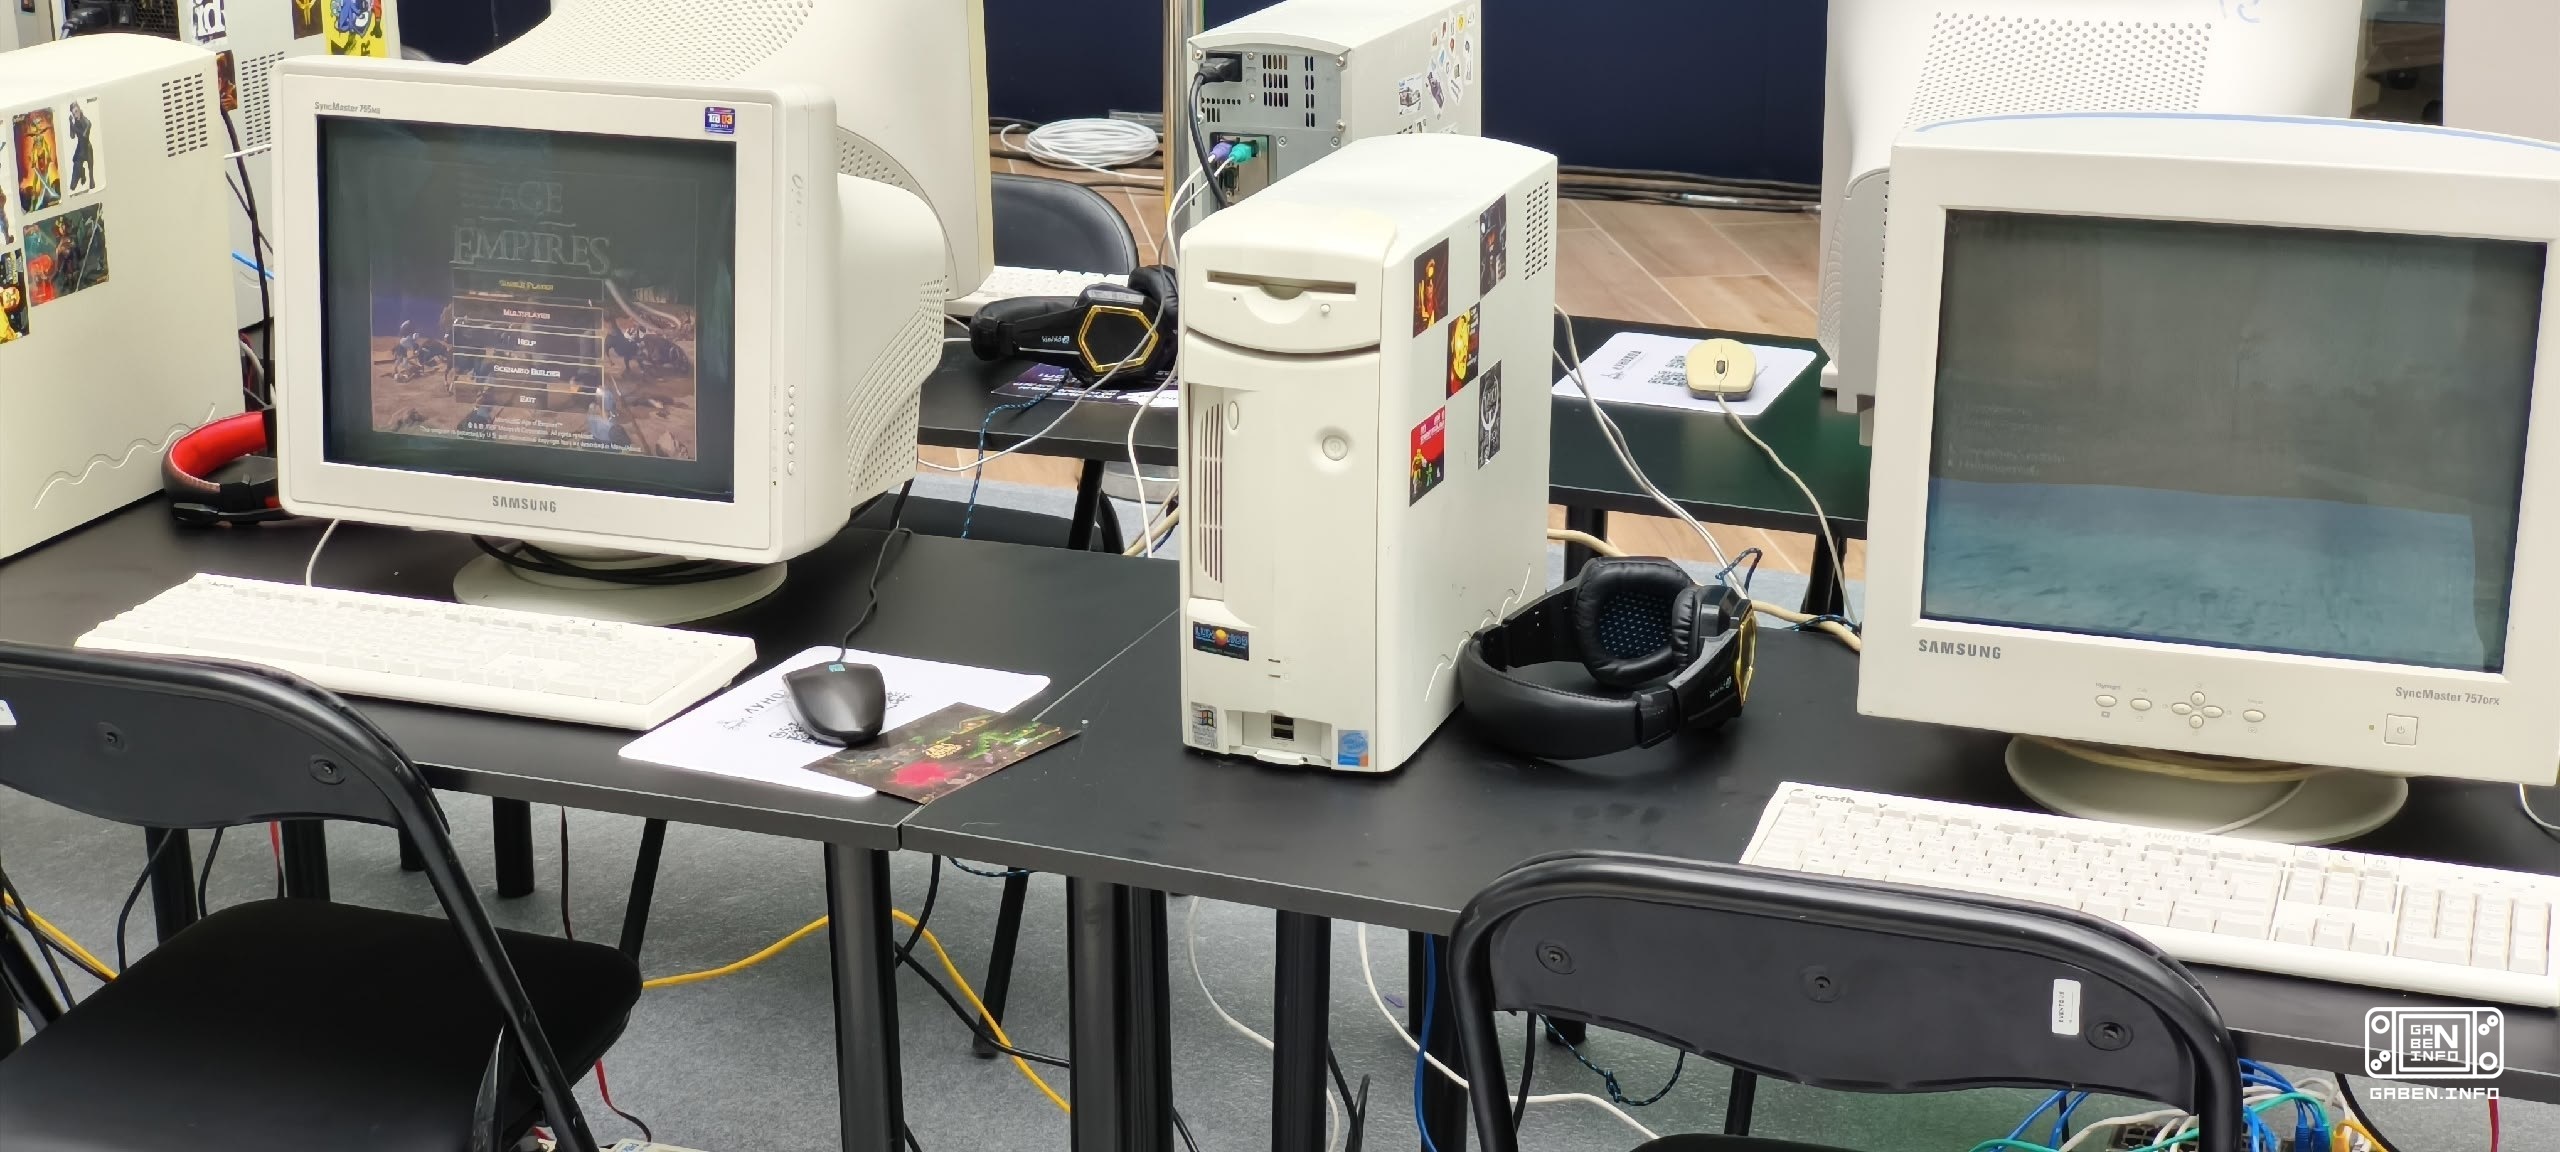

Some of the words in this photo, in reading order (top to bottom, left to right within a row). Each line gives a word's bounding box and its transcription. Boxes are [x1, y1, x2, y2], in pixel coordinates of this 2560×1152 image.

[496, 181, 564, 214] AGE
[449, 225, 610, 275] EMPIRES
[492, 495, 557, 513] SAMSUNG
[1918, 638, 2001, 660] SAMSUNG
[2395, 686, 2462, 702] SyncMaster
